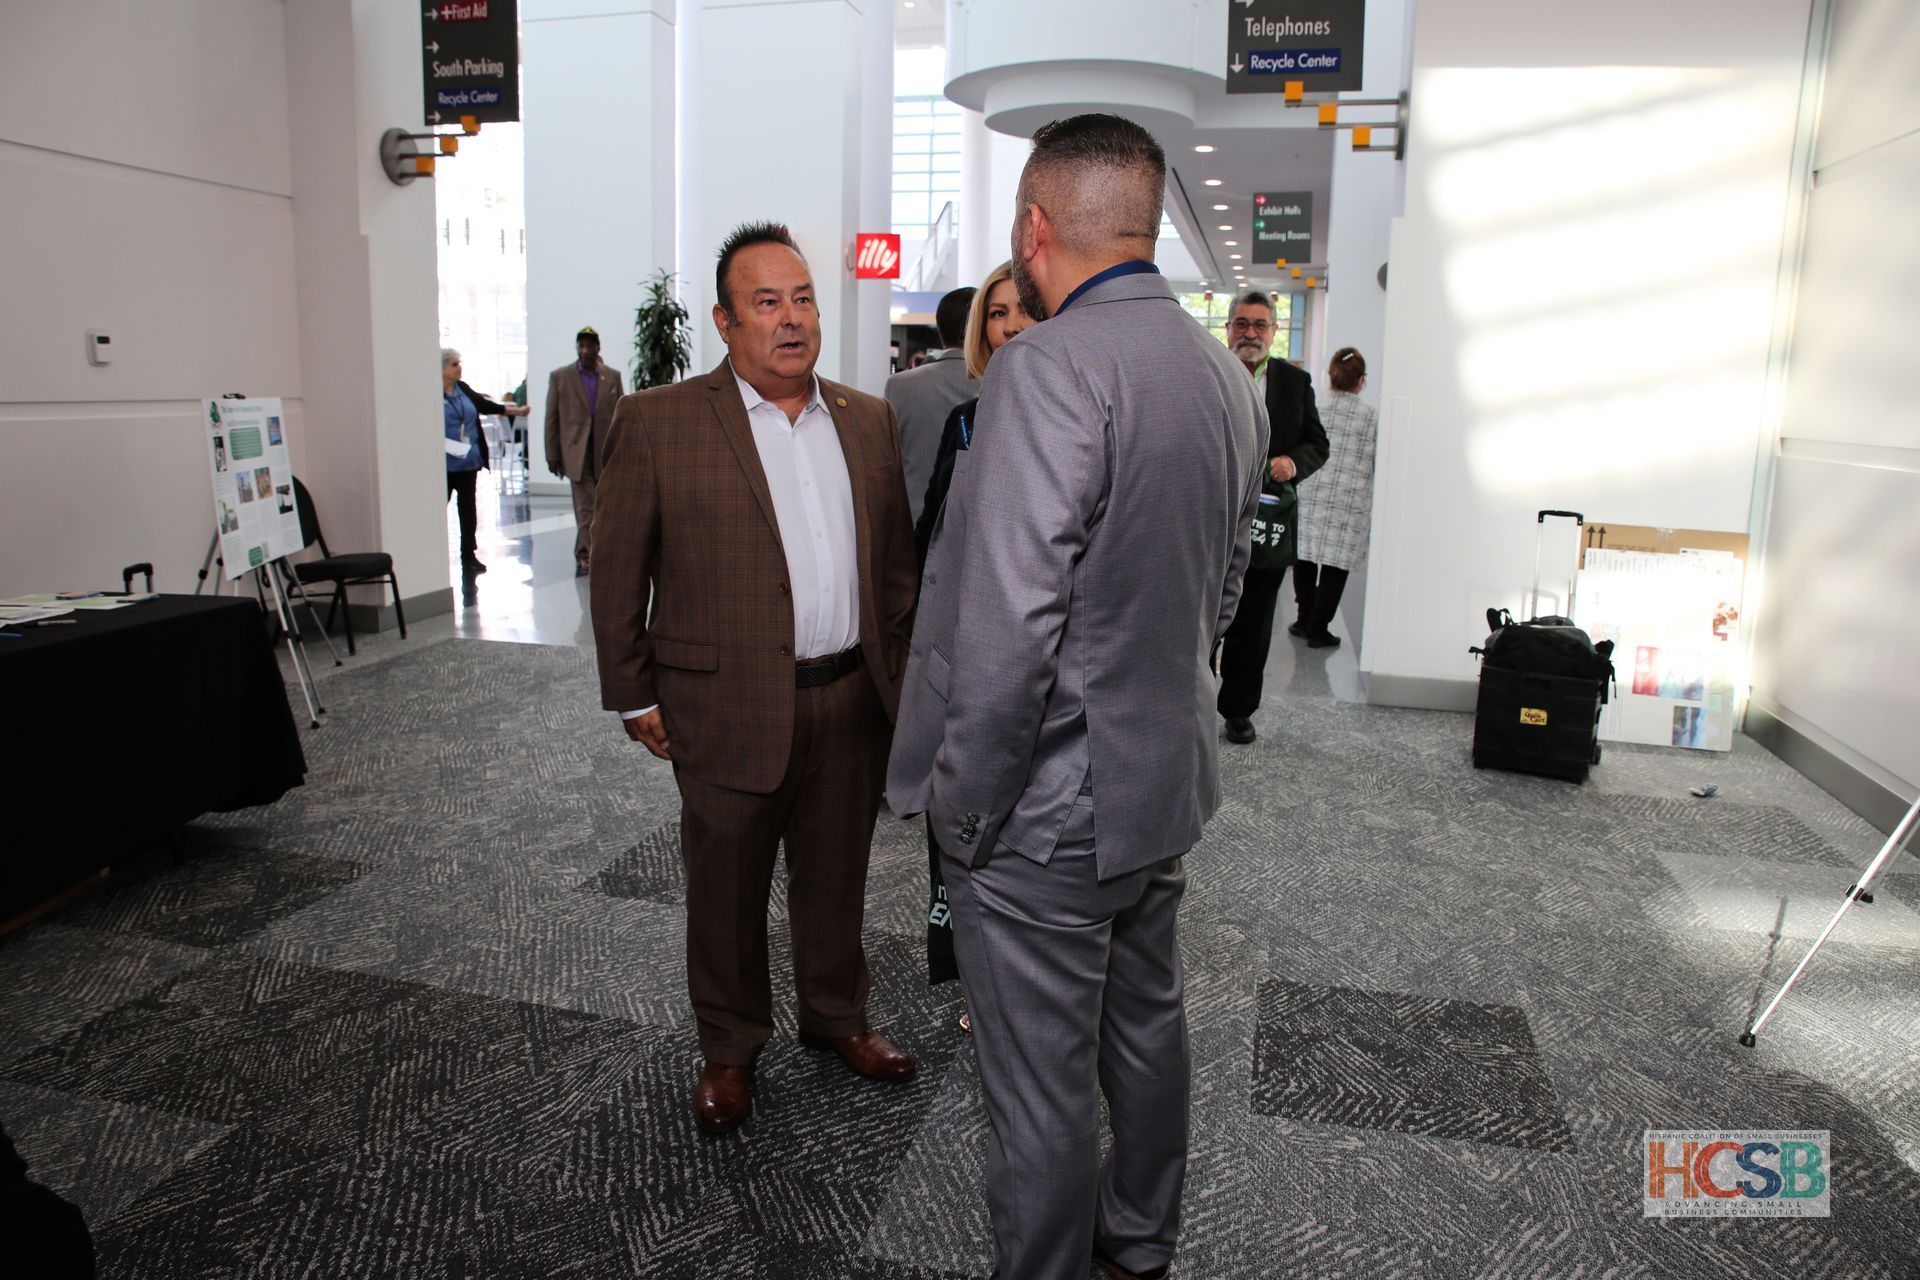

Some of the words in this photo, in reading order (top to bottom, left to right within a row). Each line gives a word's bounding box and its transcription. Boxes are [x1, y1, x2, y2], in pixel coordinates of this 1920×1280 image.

[452, 4, 471, 19] First
[473, 2, 488, 17] Aid
[1245, 16, 1331, 43] Telephones
[433, 59, 463, 78] South
[464, 58, 504, 78] Parking
[1250, 53, 1294, 73] Recycle
[1298, 53, 1337, 67] Center
[438, 91, 468, 106] Recycle
[470, 89, 498, 103] Center
[1259, 231, 1286, 242] Meeting
[1287, 230, 1310, 240] Rooms
[858, 238, 898, 275] illy
